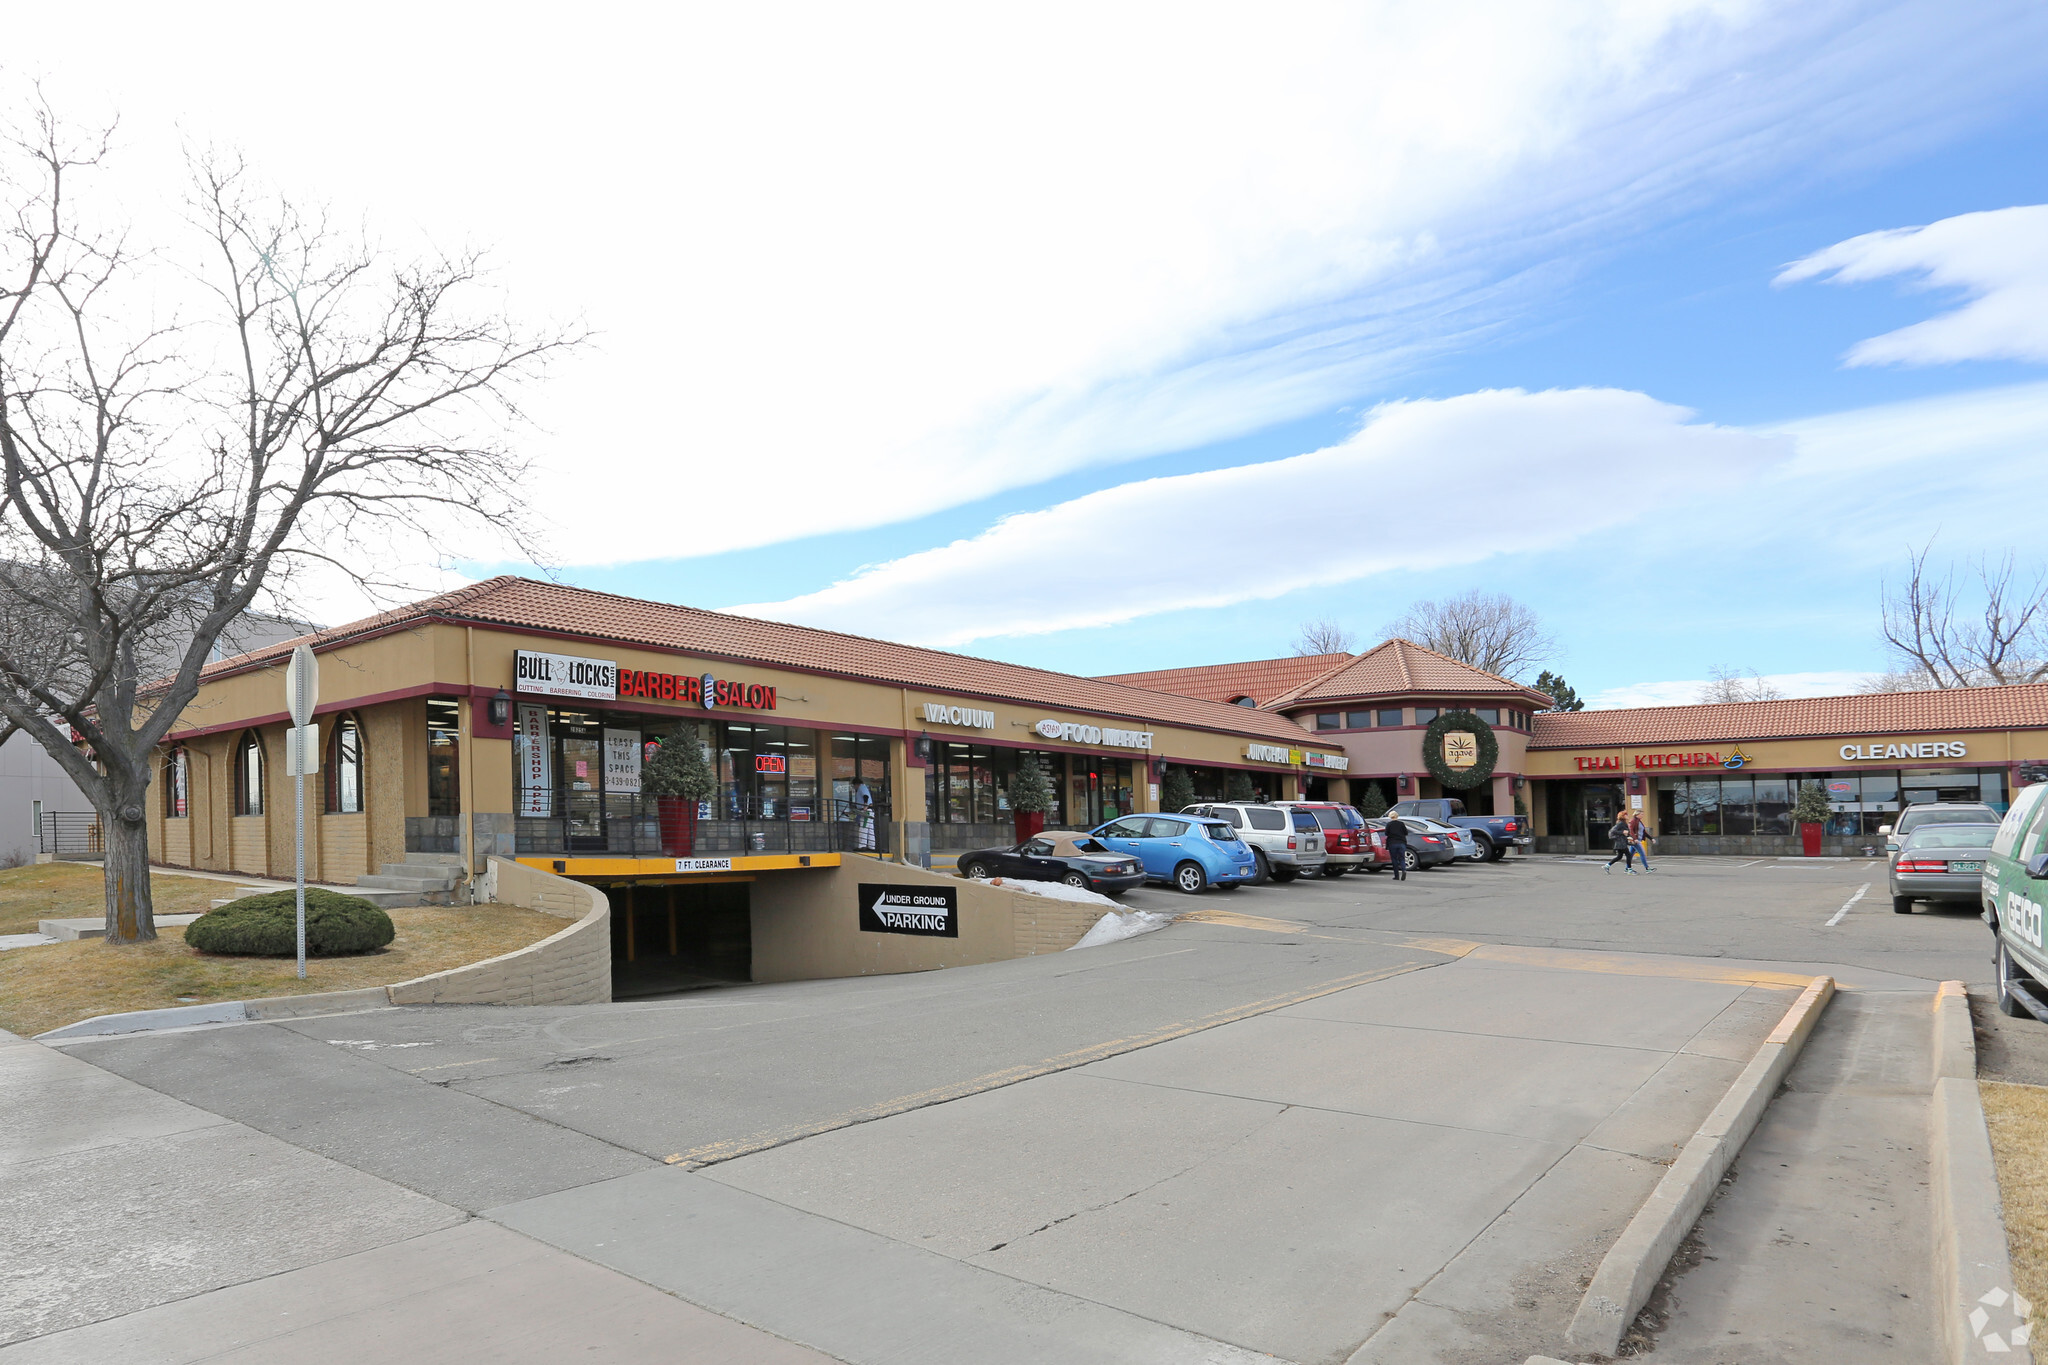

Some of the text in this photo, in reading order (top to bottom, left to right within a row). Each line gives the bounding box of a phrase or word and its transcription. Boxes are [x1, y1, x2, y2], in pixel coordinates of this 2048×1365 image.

[519, 656, 609, 687] BULL LOCKS
[550, 687, 581, 696] BARBERING
[588, 691, 614, 699] COLORING
[619, 669, 776, 710] BARBER SALON
[923, 703, 994, 729] VACUUM
[609, 737, 634, 747] LEASE
[1041, 723, 1154, 749] ASIAN FOOD MARKET
[613, 751, 630, 760] THIS
[1449, 750, 1474, 763] agave
[1840, 741, 1966, 760] CLEANERS
[529, 711, 542, 812] BARBERSHOP OPEN
[609, 764, 634, 773] SPACE
[755, 757, 785, 772] OPEN
[1574, 756, 1620, 771] THAI
[1634, 752, 1720, 769] KITCHEN
[678, 859, 729, 869] 7 FT. CLEARANCE
[886, 894, 946, 906] UNDER GROUND
[887, 913, 945, 931] PARKING
[2008, 891, 2042, 948] GEICO
